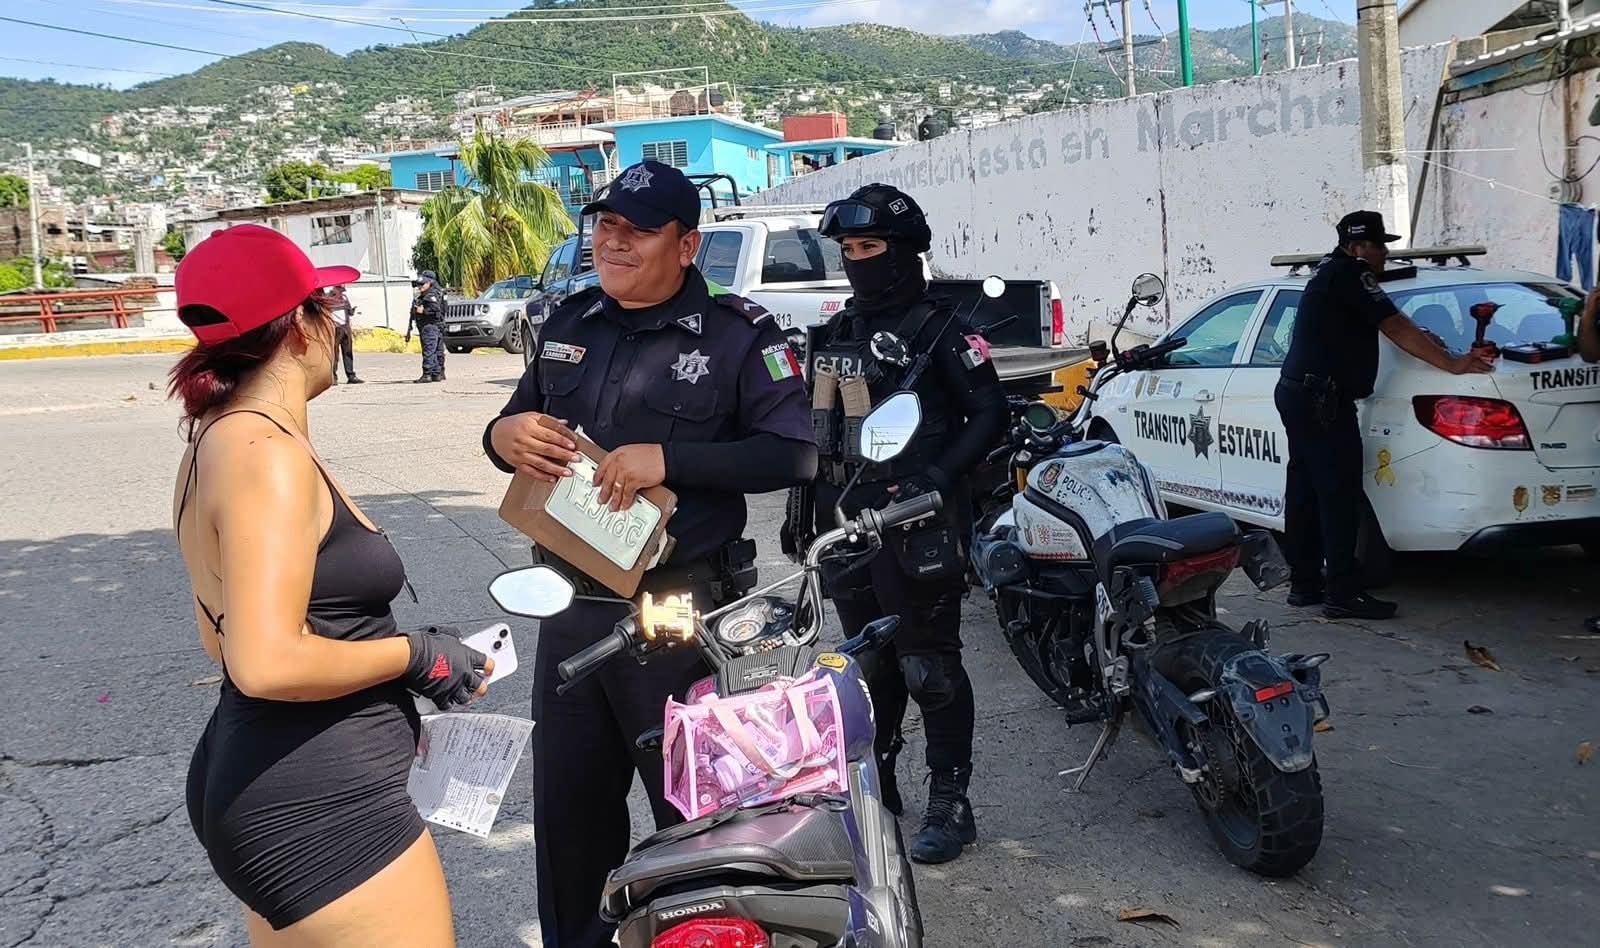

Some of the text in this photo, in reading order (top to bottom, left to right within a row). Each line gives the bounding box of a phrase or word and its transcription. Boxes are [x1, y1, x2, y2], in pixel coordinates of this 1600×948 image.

[1061, 128, 1110, 164] en
[1136, 83, 1360, 151] Marcha
[1134, 410, 1281, 464] TRANSITO ESTATAL
[1062, 475, 1091, 501] POLIC
[661, 902, 722, 920] HONDA
